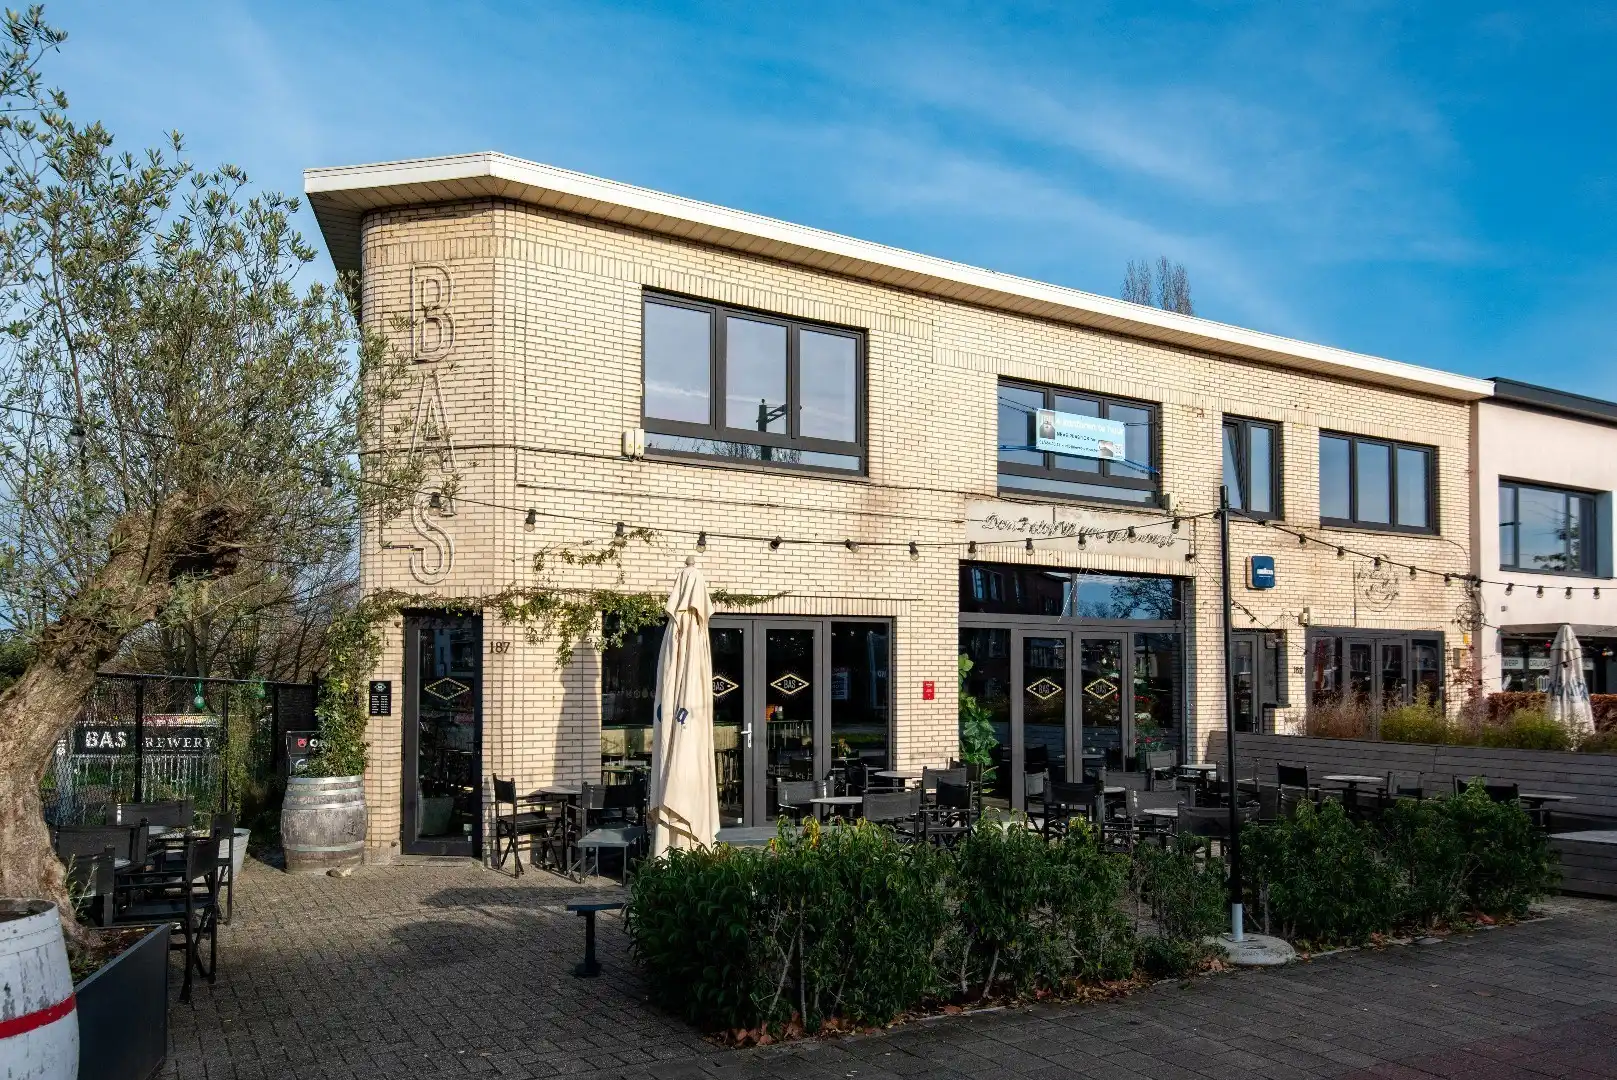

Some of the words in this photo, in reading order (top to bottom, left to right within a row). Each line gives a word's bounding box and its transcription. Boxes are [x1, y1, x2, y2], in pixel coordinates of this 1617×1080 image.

[409, 262, 456, 585] BAS
[489, 641, 511, 654] 187
[783, 679, 796, 689] BAS
[85, 731, 127, 749] BAS
[142, 737, 214, 749] REWERY
